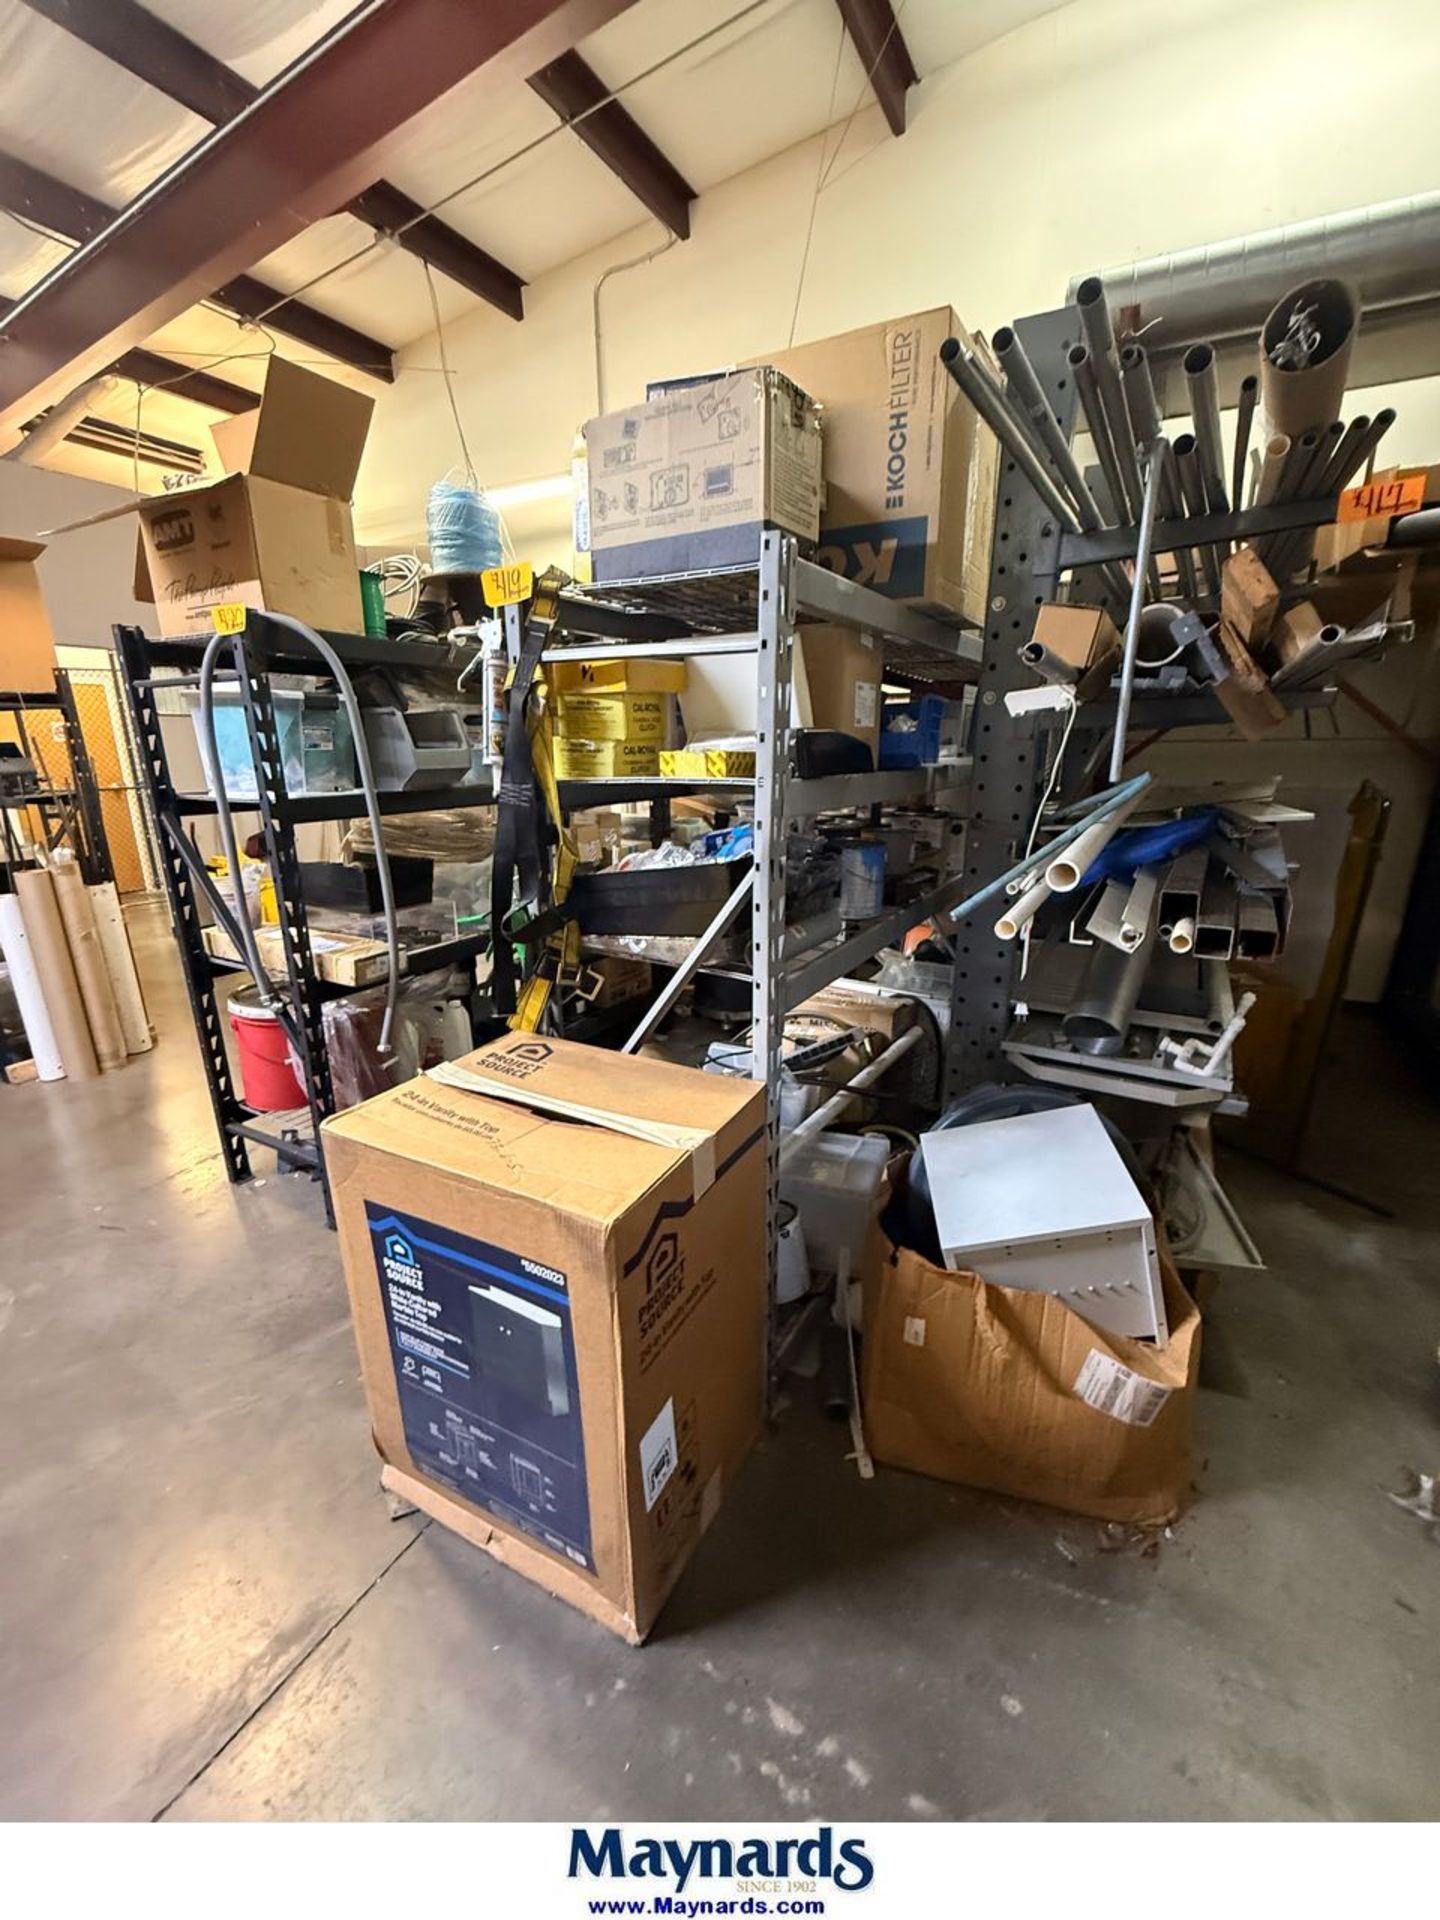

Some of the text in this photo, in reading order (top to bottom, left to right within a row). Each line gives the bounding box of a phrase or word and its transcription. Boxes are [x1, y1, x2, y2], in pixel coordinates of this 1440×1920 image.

[475, 1058, 532, 1080] SOURCE
[485, 1051, 544, 1073] PROJECT
[428, 1102, 459, 1119] Vanity
[457, 1114, 481, 1127] with
[479, 1120, 501, 1134] Top
[383, 1256, 424, 1281] PROJECT
[386, 1268, 425, 1292] SOURCE
[637, 1257, 687, 1324] PROJECT
[639, 1278, 686, 1340] SOURCE
